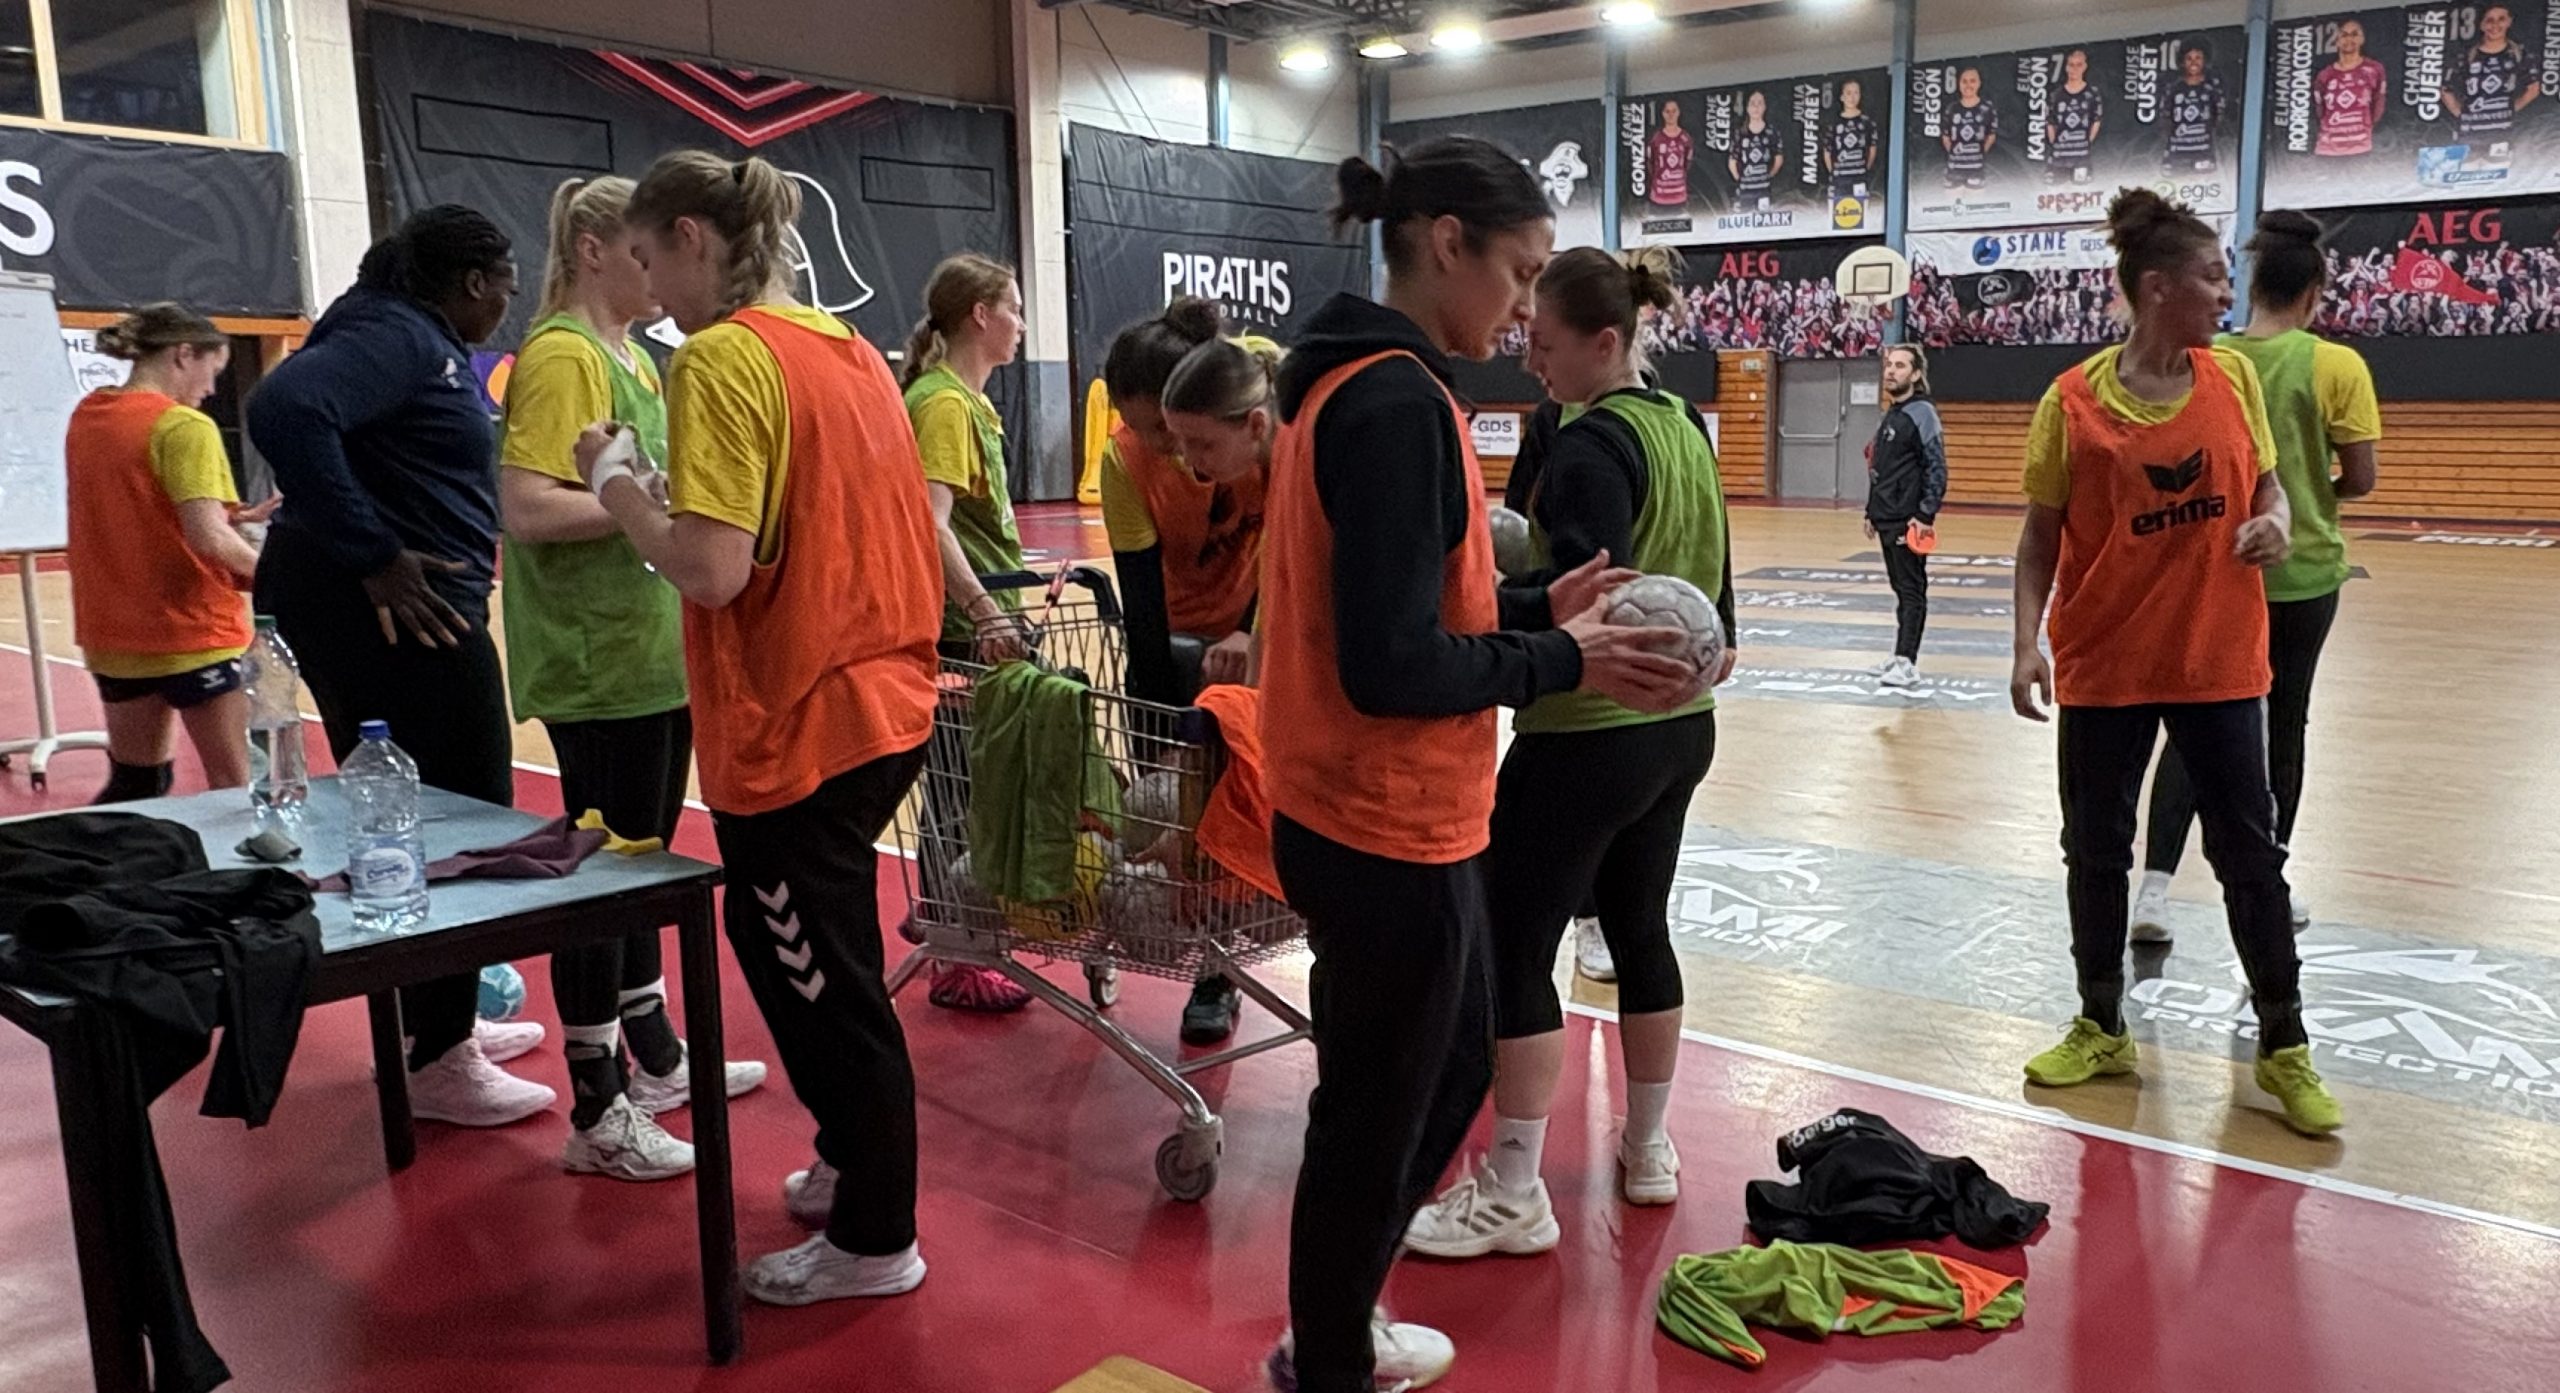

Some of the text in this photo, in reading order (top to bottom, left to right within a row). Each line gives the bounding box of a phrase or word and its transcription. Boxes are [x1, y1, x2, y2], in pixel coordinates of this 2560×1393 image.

[2315, 22, 2340, 55] 12
[2450, 7, 2476, 41] 13
[1945, 66, 1957, 94] 6
[2017, 57, 2031, 93] ELIN
[2051, 54, 2065, 83] 7
[2124, 45, 2139, 101] LOUISE
[2137, 44, 2158, 123] CUSSET
[2418, 9, 2447, 122] GUERRIER
[1793, 84, 1805, 122] JULIA
[1913, 69, 1925, 114] LILOU
[1924, 68, 1941, 137] BEGON
[2027, 57, 2048, 161] KARLSSON
[1706, 95, 1718, 149] AGATHE
[1716, 94, 1731, 151] CLERC
[1802, 84, 1820, 184] MAUFFREY
[0, 160, 55, 256] S
[2179, 183, 2221, 203] egis
[2006, 231, 2067, 254] STANE
[2408, 208, 2502, 246] AEG
[1163, 252, 1292, 316] PIRATHS
[1719, 251, 1780, 279] AEG
[1219, 304, 1279, 328] DBALL
[2131, 495, 2226, 537] erima
